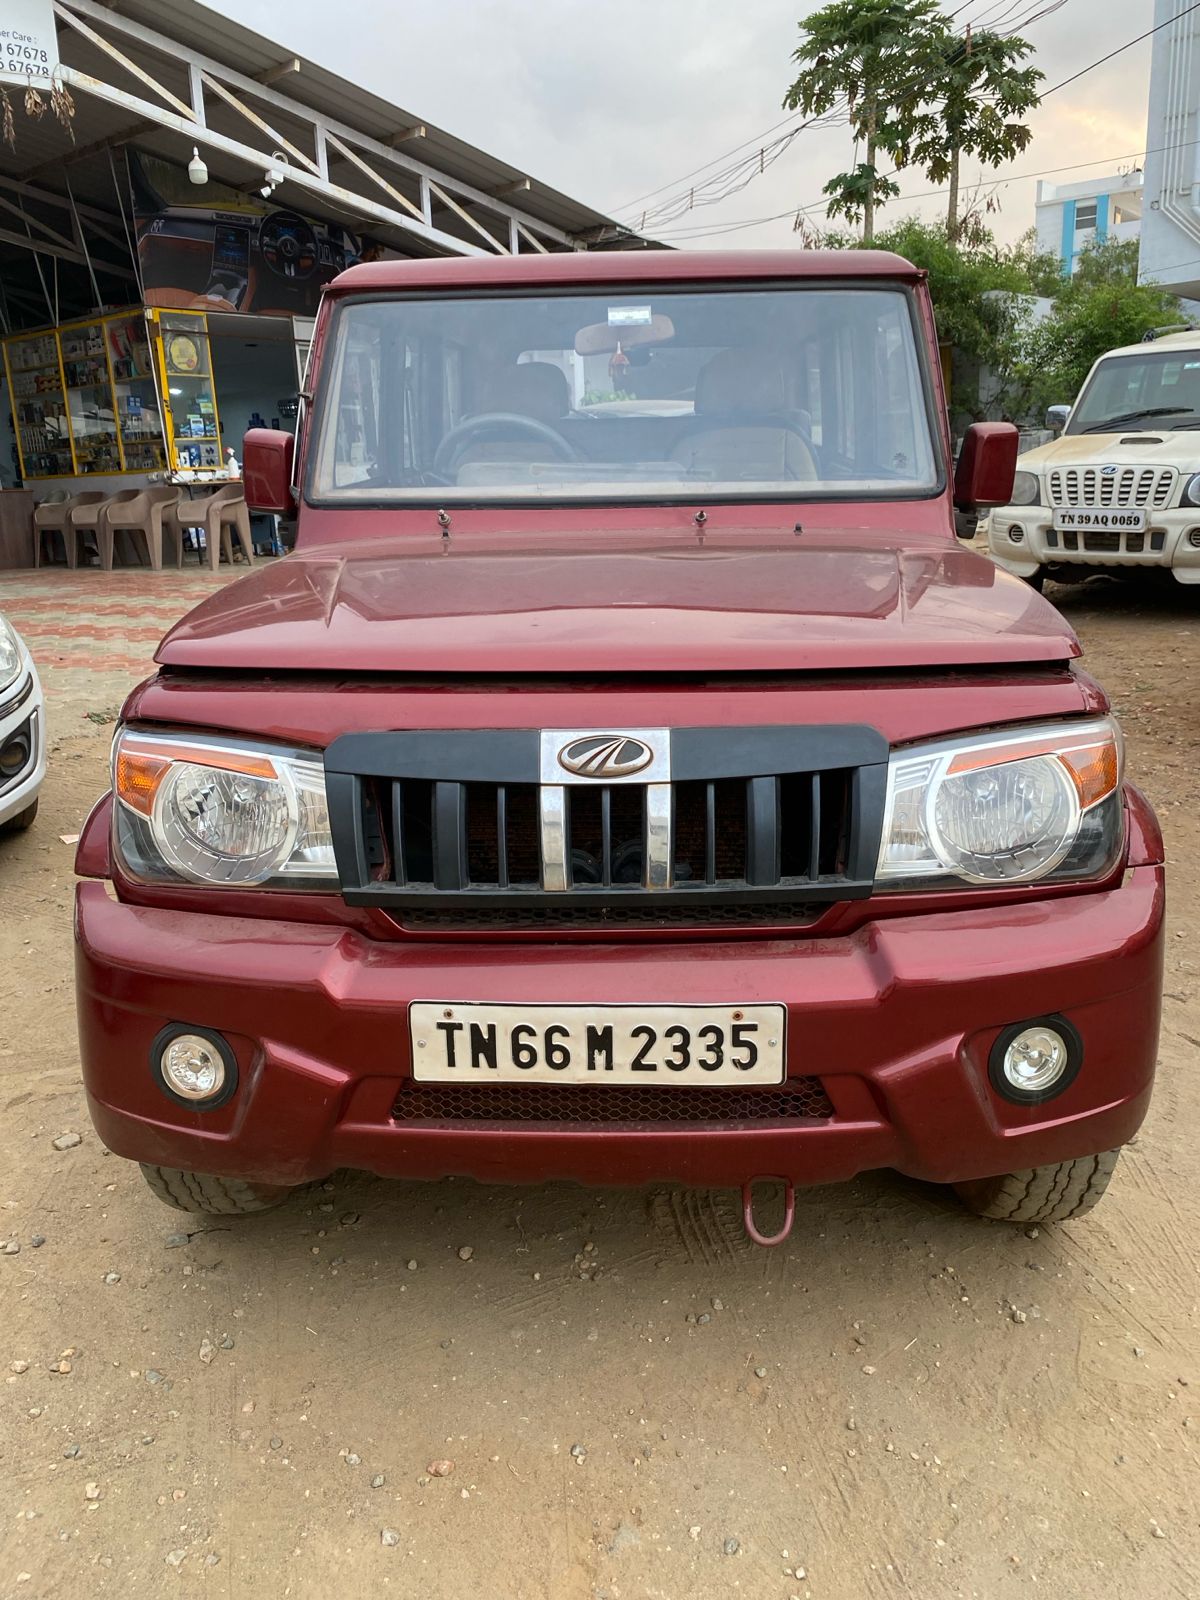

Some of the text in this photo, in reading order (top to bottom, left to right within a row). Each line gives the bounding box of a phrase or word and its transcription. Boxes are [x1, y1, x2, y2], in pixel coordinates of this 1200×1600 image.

[0, 30, 10, 38] er
[6, 43, 48, 63] 67678
[1060, 514, 1140, 527] TN 39 AQ 0059
[437, 1021, 758, 1071] TN 66 M 2335
